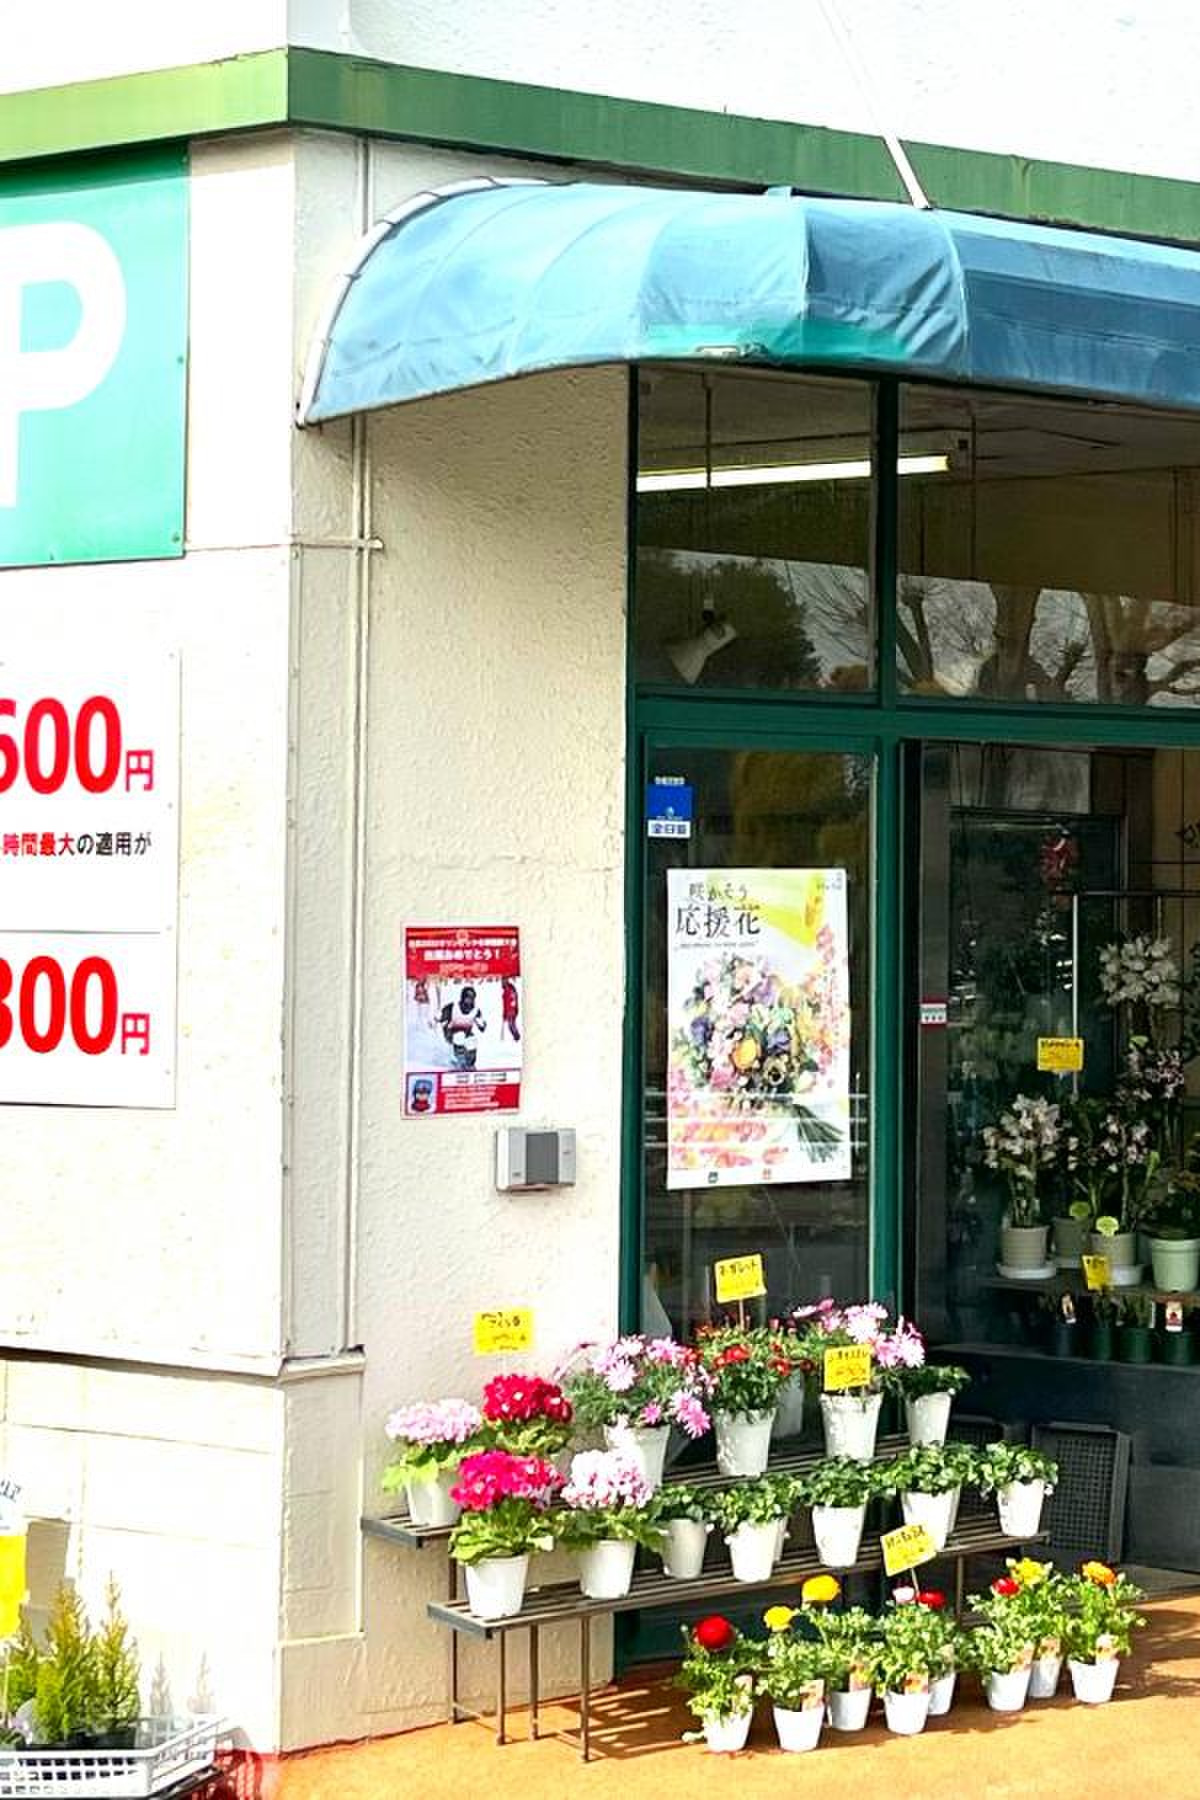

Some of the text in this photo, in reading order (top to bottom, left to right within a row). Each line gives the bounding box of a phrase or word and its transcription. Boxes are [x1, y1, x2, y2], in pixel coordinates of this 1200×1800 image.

[0, 220, 127, 510] P
[675, 904, 762, 939] 応援花
[0, 955, 151, 1056] 00円
